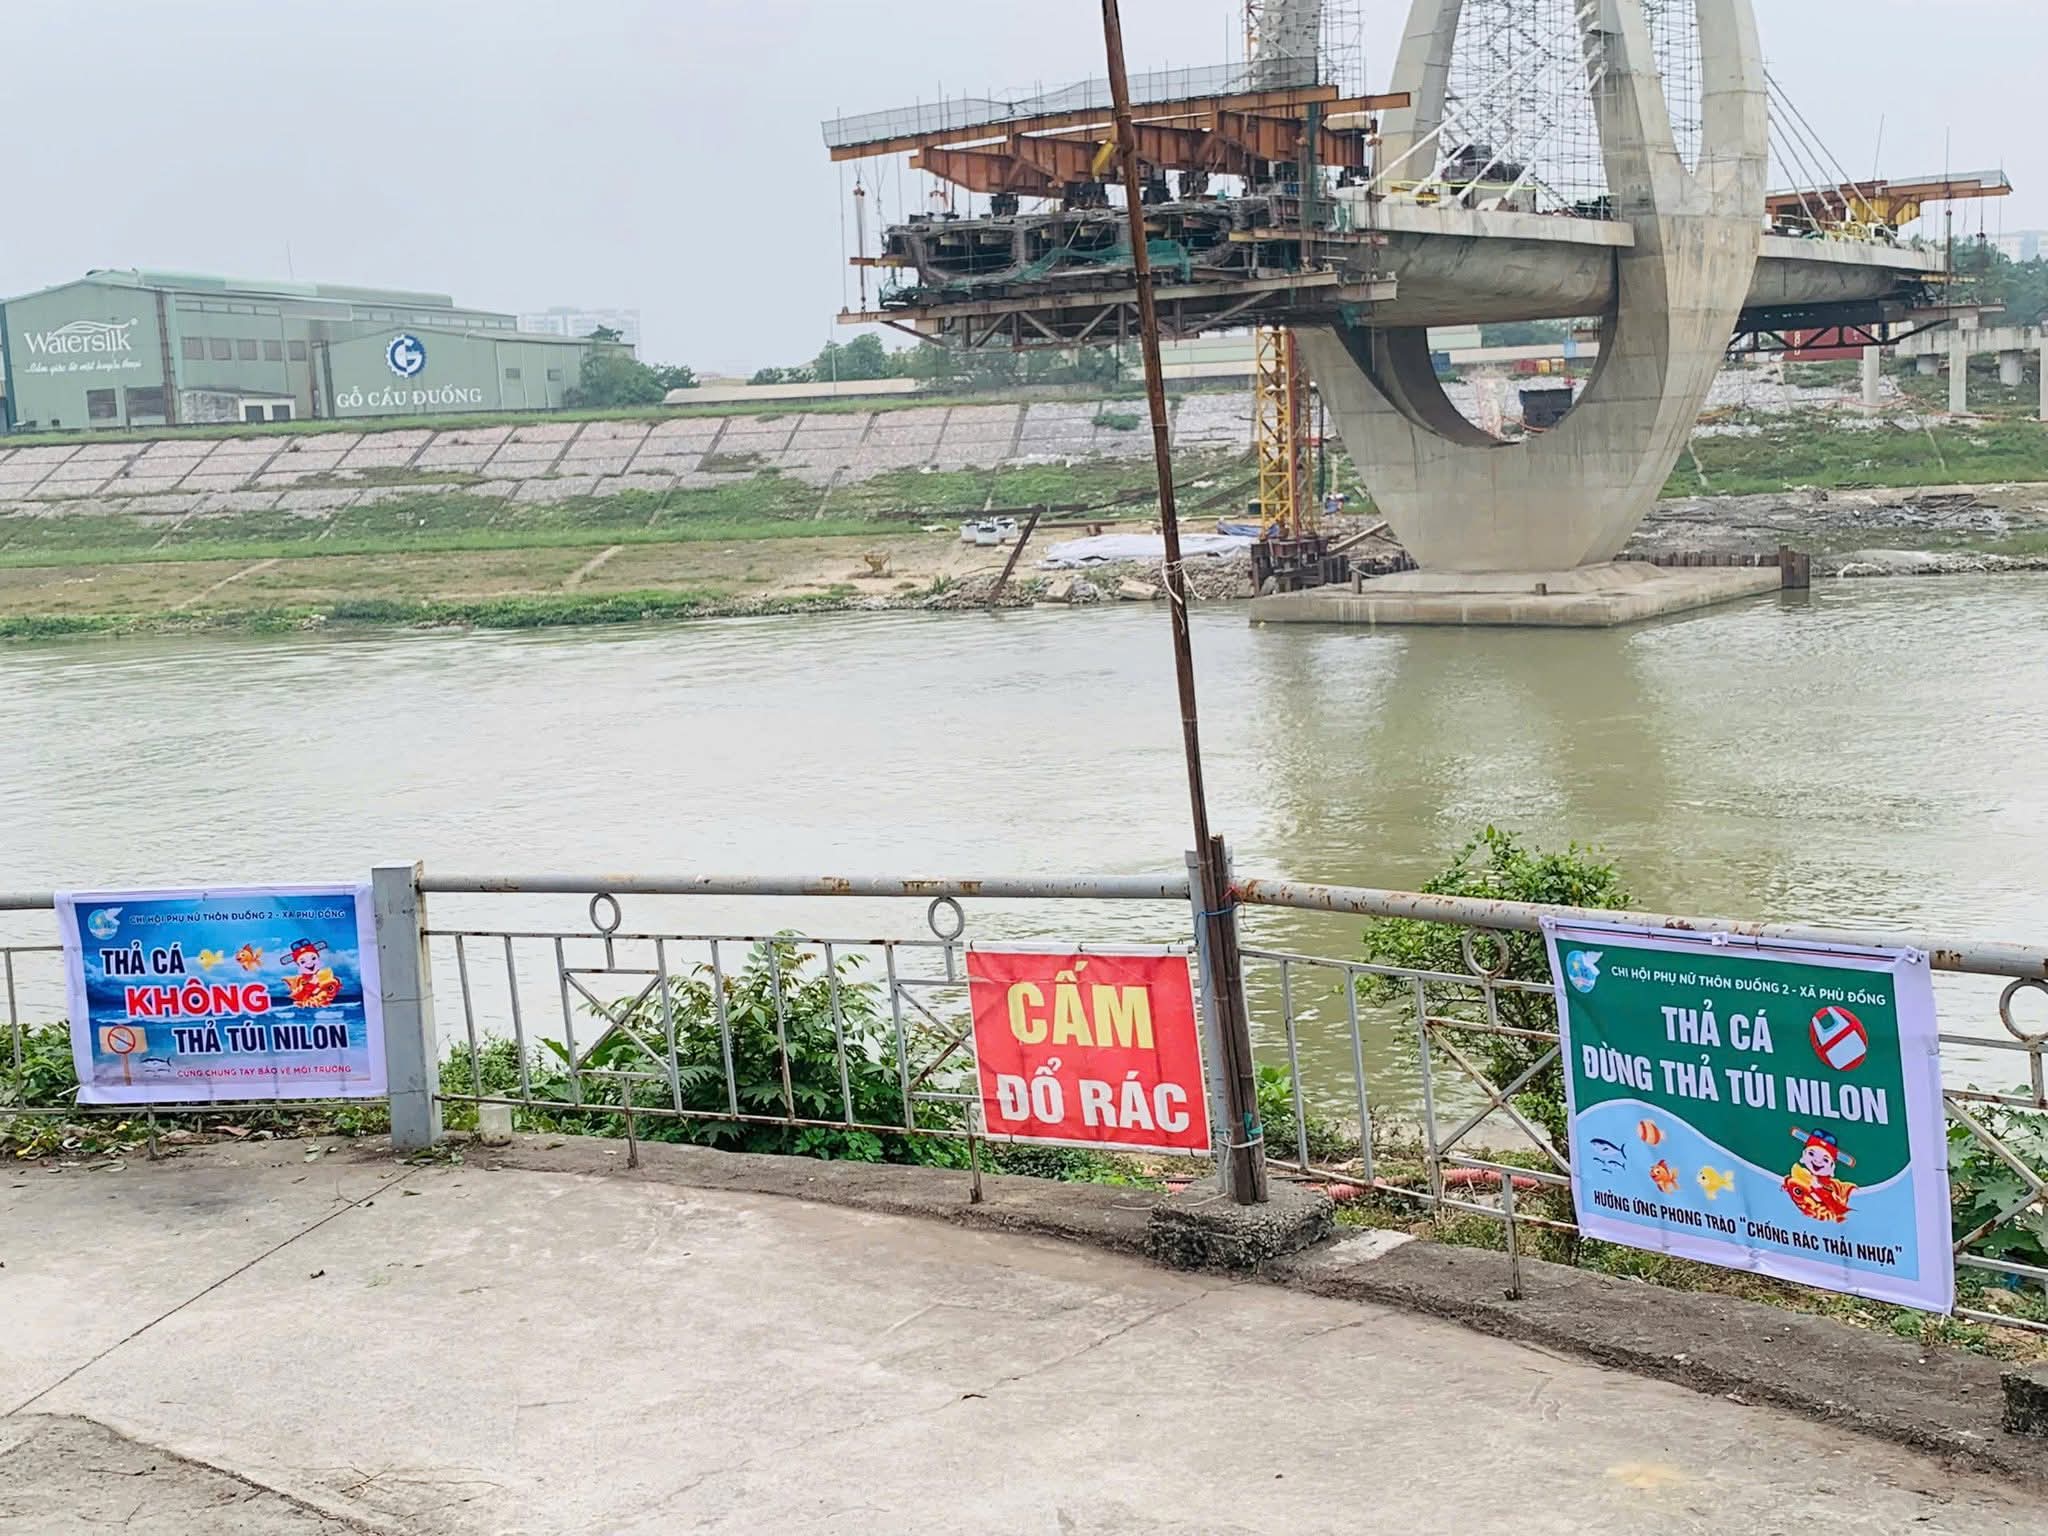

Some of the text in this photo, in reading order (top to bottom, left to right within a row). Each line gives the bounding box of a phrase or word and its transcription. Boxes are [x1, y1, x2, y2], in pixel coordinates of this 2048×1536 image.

[24, 329, 132, 354] Watersilk
[203, 911, 229, 921] THÔN
[267, 911, 273, 919] 2
[101, 941, 186, 975] THẢ CÁ
[125, 978, 269, 1017] KHÔNG
[1611, 966, 1629, 978] CHI
[1631, 966, 1651, 983] HỘI
[1653, 971, 1677, 986] PHỤ
[1679, 972, 1697, 985] NỮ
[1699, 974, 1732, 989] THÔN
[1735, 977, 1780, 993] ĐUỐNG
[1782, 984, 1790, 995] 2
[1800, 984, 1817, 998] XÃ
[1819, 987, 1844, 1001] PHÙ
[1007, 960, 1155, 1049] CẤM
[173, 1020, 349, 1054] THẢ TÚI NILON
[1661, 999, 1774, 1054] THẢ CÁ
[204, 1069, 237, 1077] CHUNG
[239, 1068, 256, 1076] TAY
[1582, 1041, 1889, 1126] ĐỪNG THẢ TÚI NILON
[996, 1057, 1190, 1134] ĐỔ RÁC
[1593, 1189, 1630, 1213] HƯỞNG
[1632, 1197, 1658, 1218] ỨNG
[1660, 1205, 1703, 1227] PHONG
[1705, 1213, 1737, 1235] TRÀO
[1792, 1230, 1820, 1251] RÁC
[1822, 1235, 1853, 1258] THẢI
